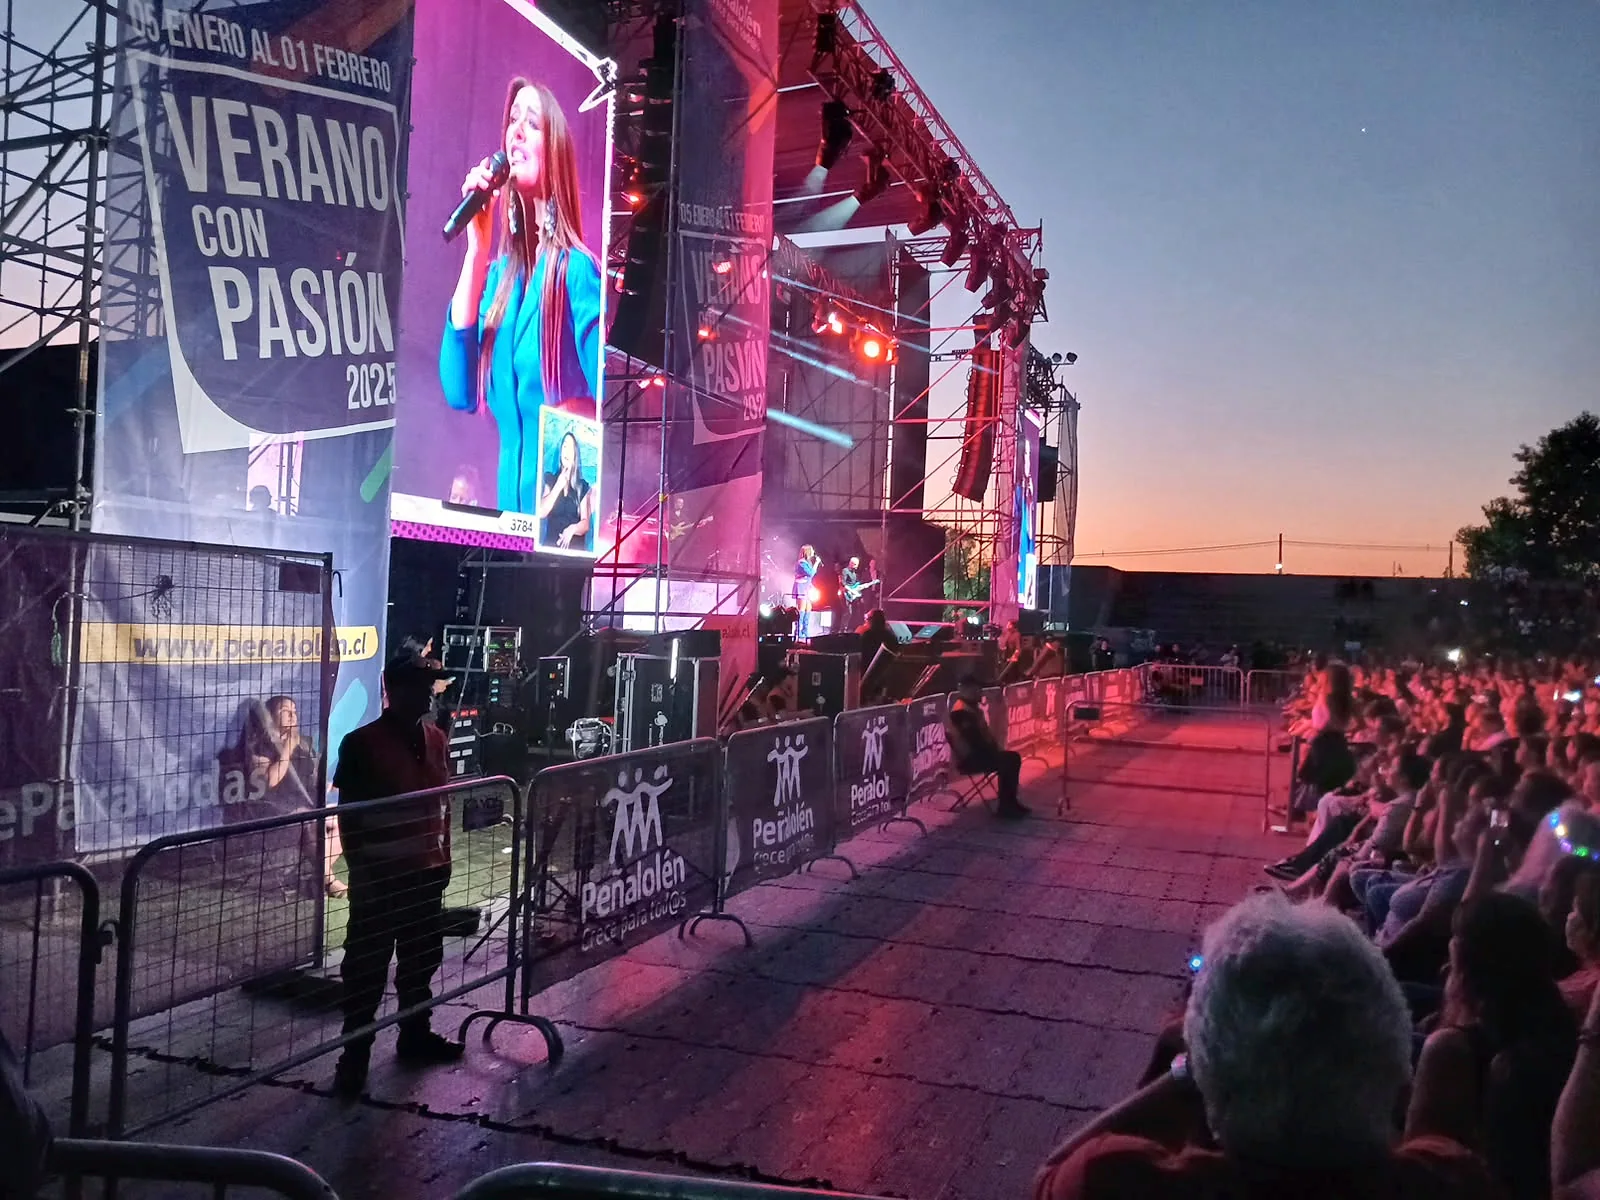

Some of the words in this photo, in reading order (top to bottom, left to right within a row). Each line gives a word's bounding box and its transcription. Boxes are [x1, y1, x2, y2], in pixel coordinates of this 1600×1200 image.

[127, 0, 160, 42] 05
[164, 9, 246, 59] ENERO
[251, 28, 279, 66] AL
[281, 36, 309, 73] 01
[313, 43, 391, 93] FEBRERO
[162, 90, 389, 212] VERANO
[192, 205, 269, 258] CON
[207, 252, 395, 361] PASIÓN
[346, 361, 396, 410] 2025
[702, 330, 765, 395] PASIÓN
[510, 518, 533, 532] 3784
[581, 849, 686, 924] Peñalolén
